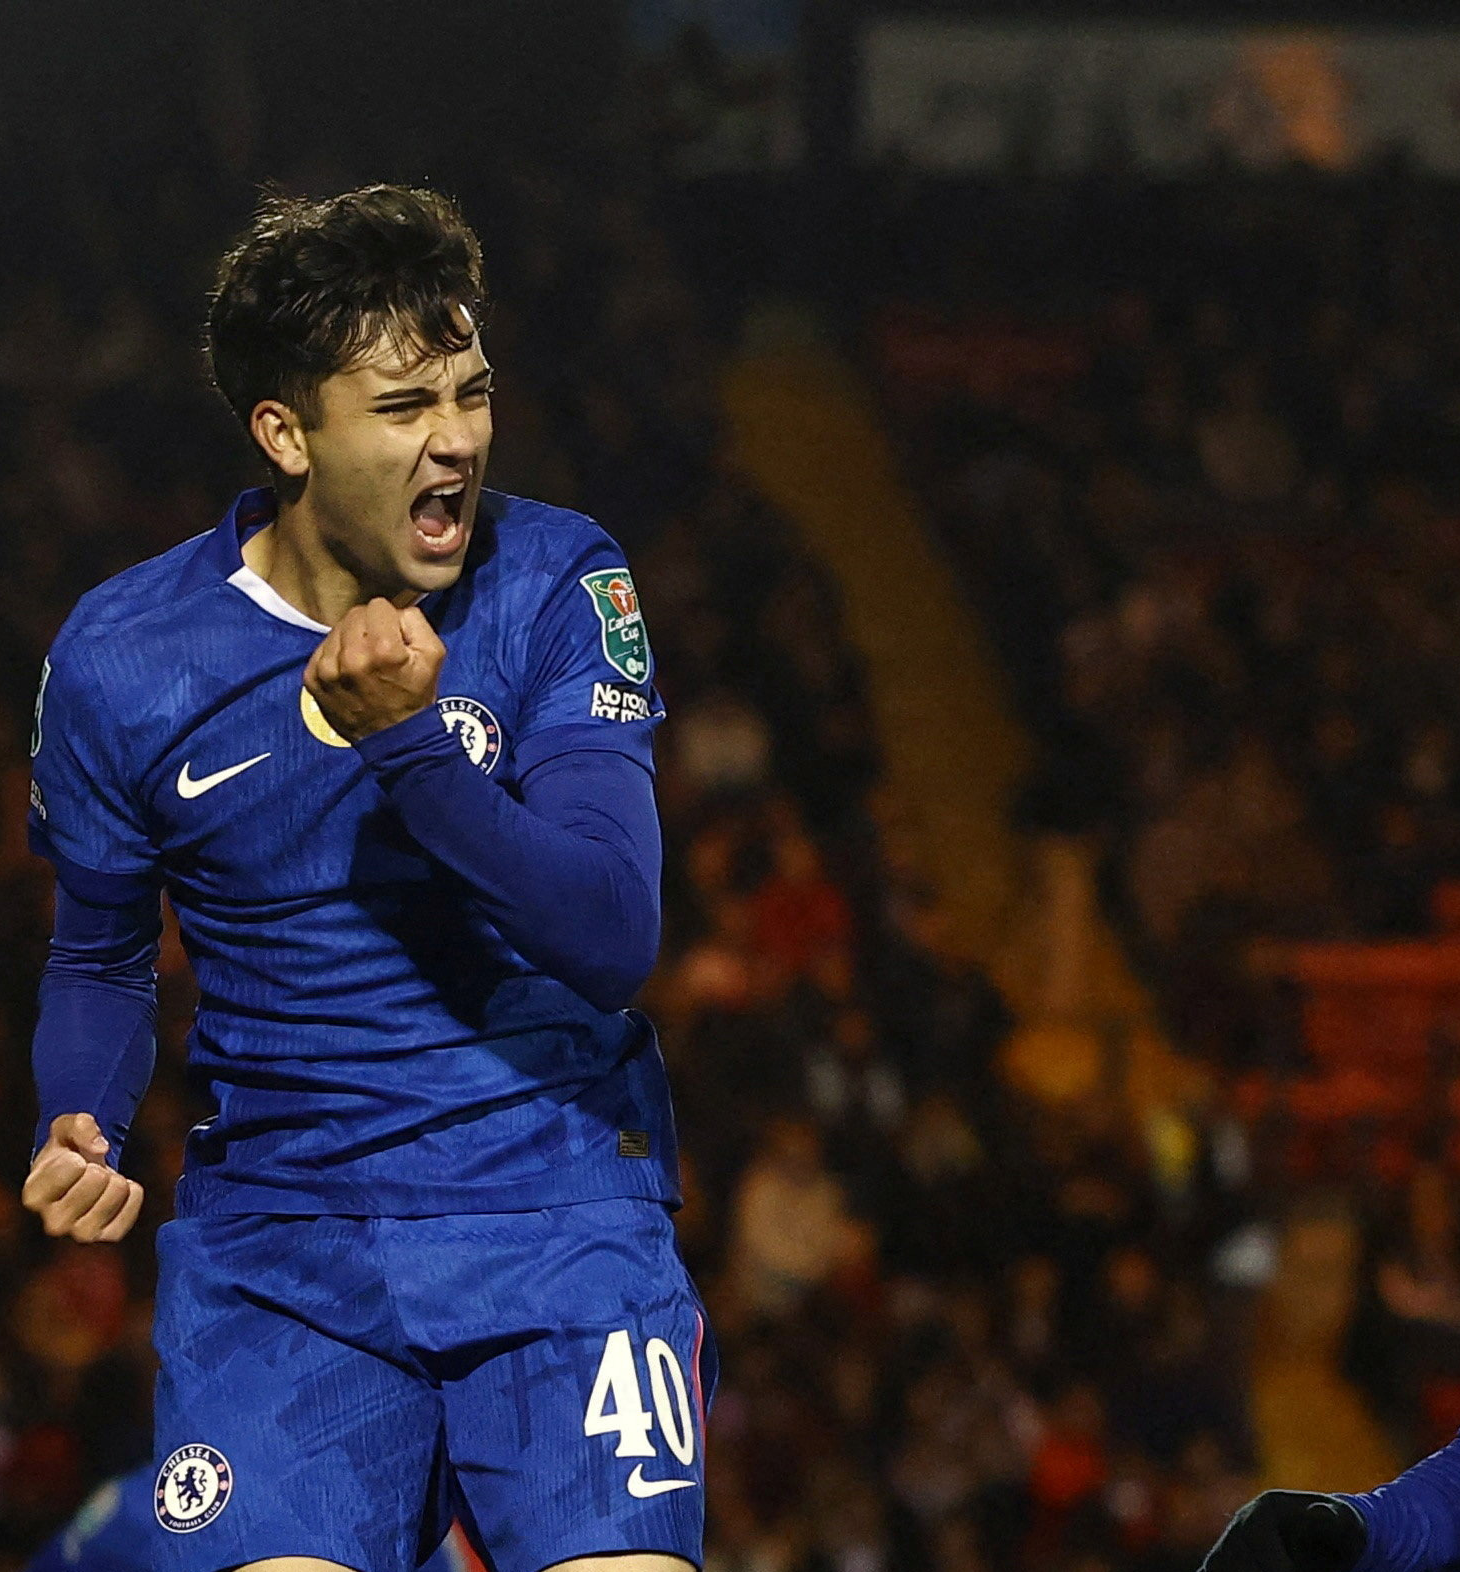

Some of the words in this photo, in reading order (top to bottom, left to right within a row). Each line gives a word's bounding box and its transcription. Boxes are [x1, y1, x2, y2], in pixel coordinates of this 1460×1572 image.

[593, 682, 621, 705] No
[438, 701, 482, 718] ELSEA
[584, 1329, 694, 1466] 40
[162, 1447, 211, 1478] CHELSEA
